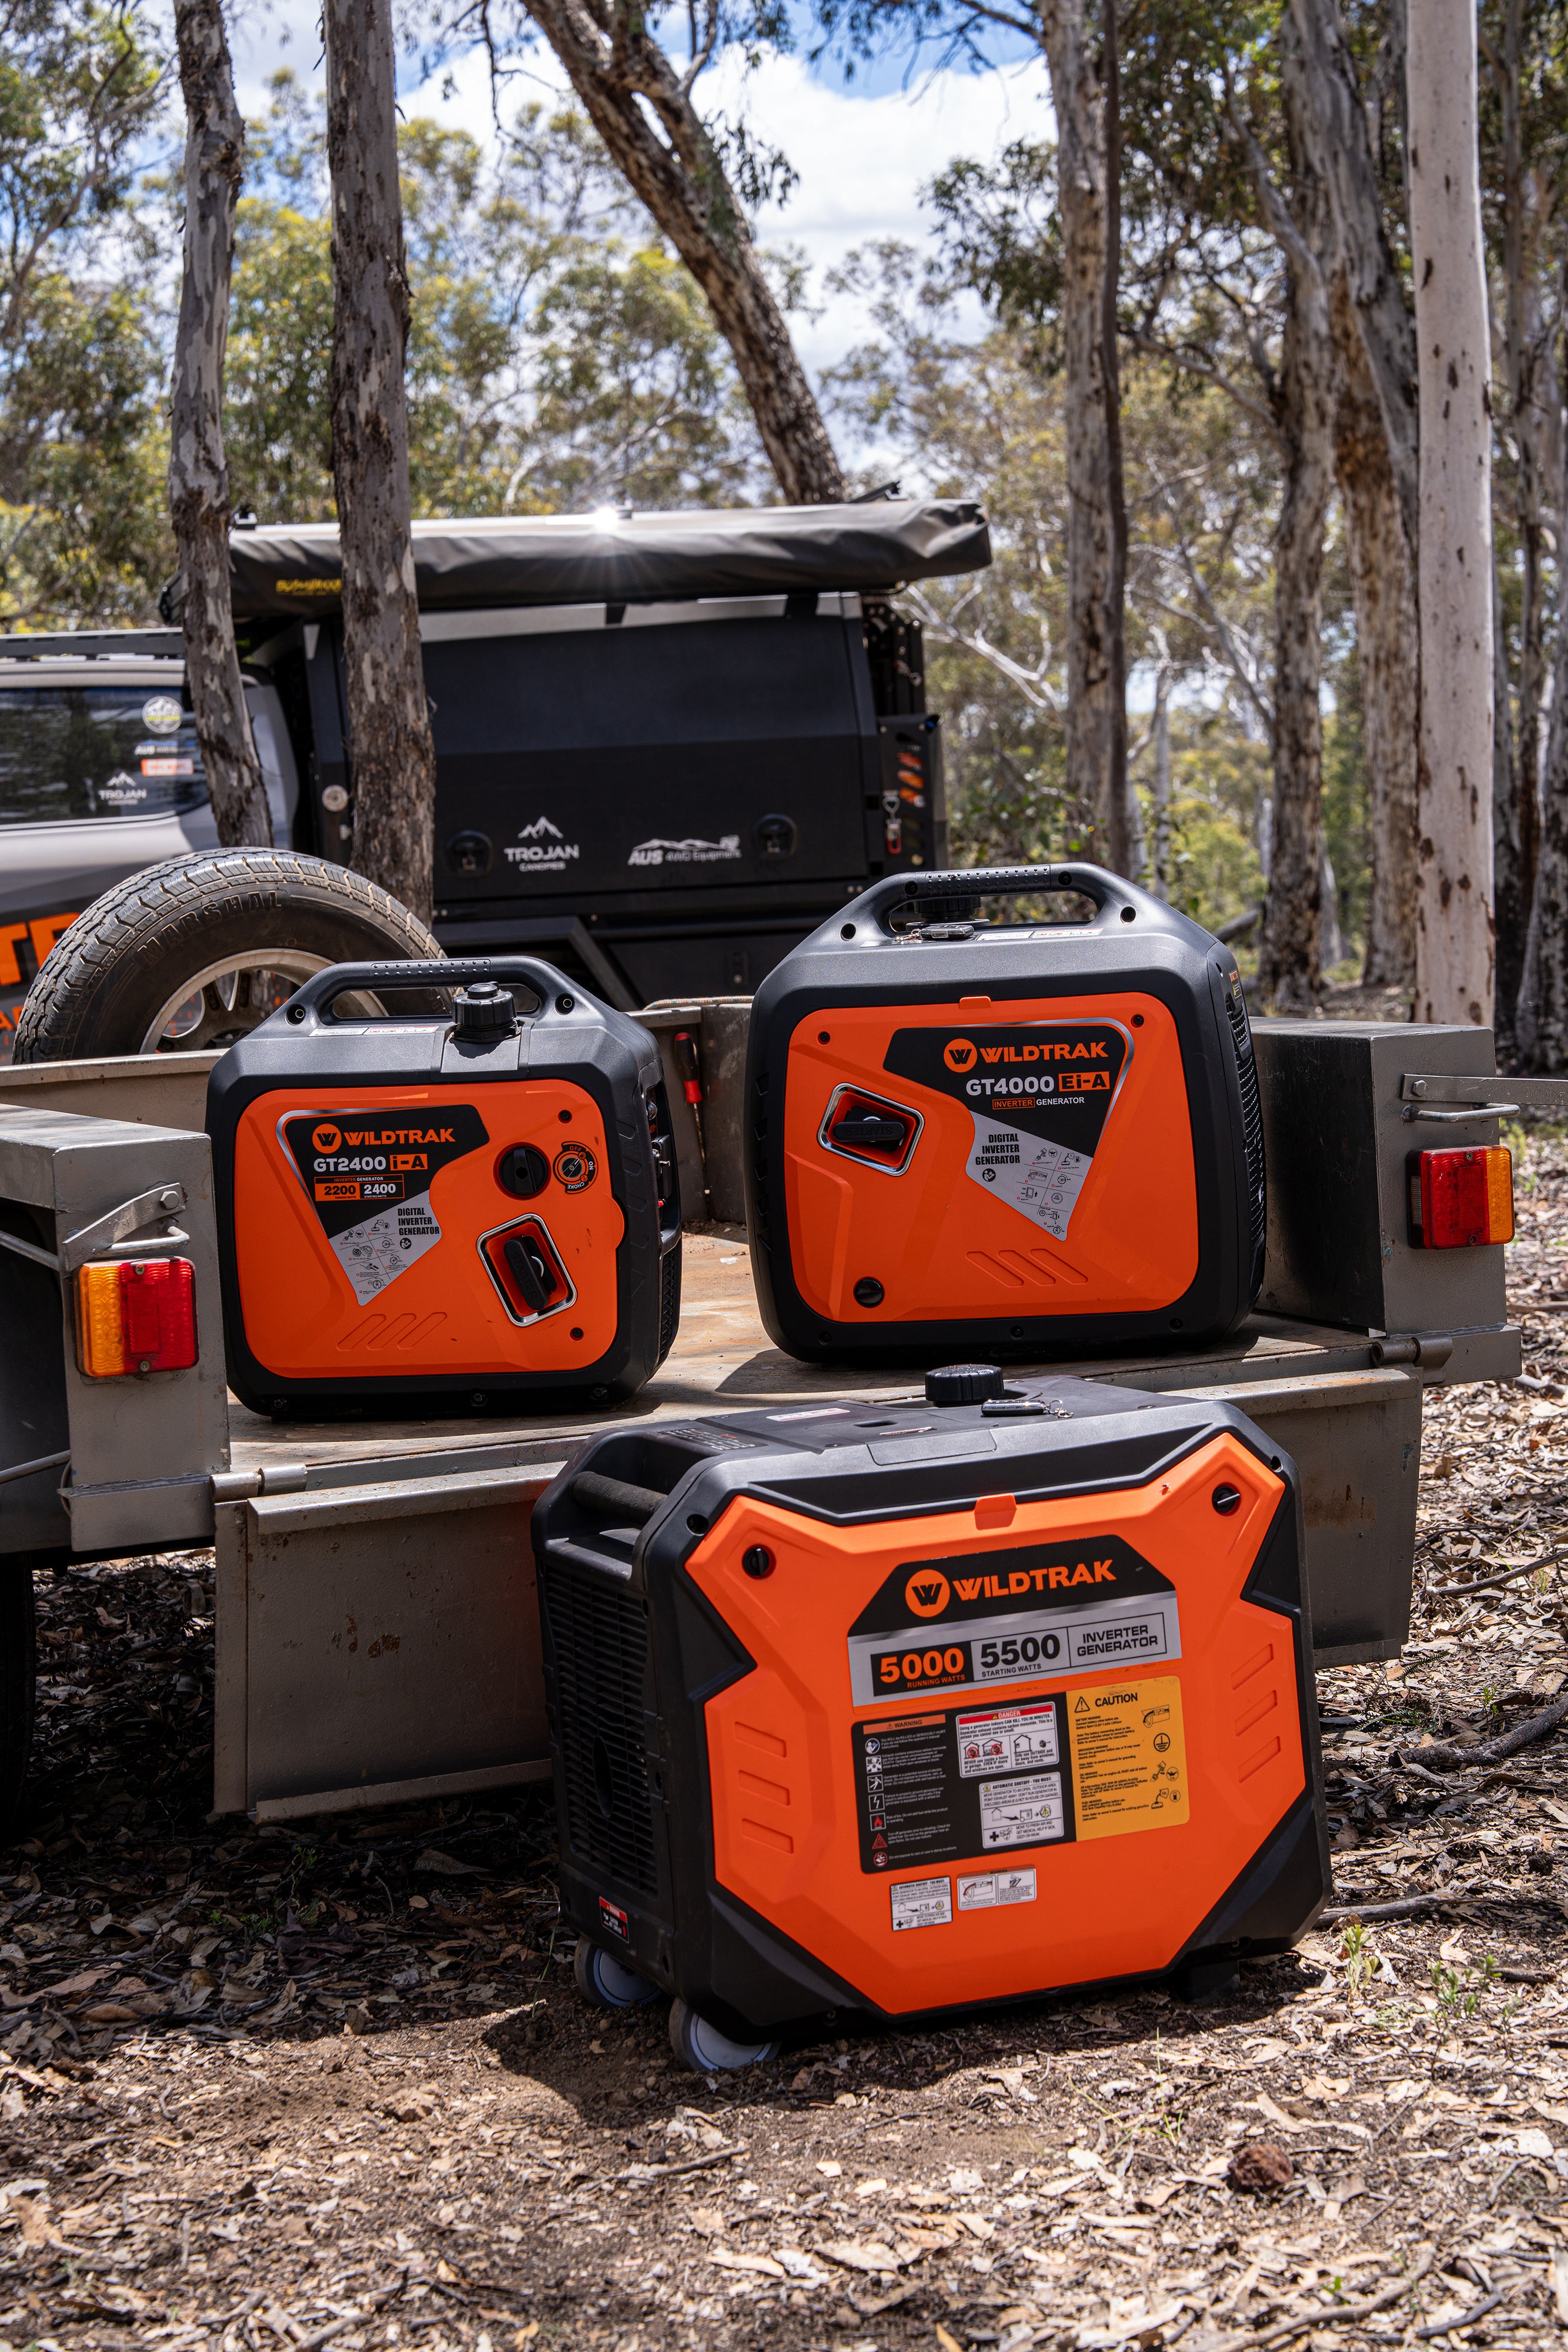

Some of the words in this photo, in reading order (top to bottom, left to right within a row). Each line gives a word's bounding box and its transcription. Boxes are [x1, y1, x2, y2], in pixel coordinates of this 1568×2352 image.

[98, 789, 146, 800] TROJAN
[504, 844, 579, 862] TROJAN
[627, 849, 664, 866] AUS
[665, 851, 692, 862] 4WD
[519, 861, 566, 872] CANOPIES
[137, 890, 282, 965] MARSHAL
[979, 1042, 1108, 1063] WILDTRAK
[966, 1076, 1054, 1095] GT4000
[1062, 1074, 1106, 1089] Ei-A
[994, 1100, 1033, 1108] INVERTER
[1037, 1097, 1085, 1105] GENERATOR
[343, 1128, 456, 1146] WILDTRAK
[845, 1126, 893, 1136] STARTER
[988, 1133, 1019, 1143] DIGITAL
[982, 1144, 1019, 1154] INVERTER
[313, 1156, 386, 1172] GT2400
[393, 1155, 425, 1169] i-A
[589, 1161, 593, 1170] ON
[975, 1155, 1020, 1165] GENERATOR
[324, 1185, 356, 1195] 2200
[364, 1184, 396, 1194] 2400
[397, 1207, 425, 1216] DIGITAL
[398, 1217, 432, 1226] INVERTER
[399, 1226, 440, 1235] GENERATOR
[952, 1559, 1116, 1602] WILDTRAK
[1082, 1624, 1149, 1643] INVERTER
[979, 1633, 1061, 1669] 5500
[1076, 1635, 1158, 1657] GENERATOR
[880, 1647, 964, 1683] 5000
[981, 1667, 1017, 1678] STARTING
[1018, 1663, 1042, 1673] WATTS
[907, 1678, 940, 1689] RUNNING
[941, 1674, 965, 1685] WATTS
[1095, 1692, 1138, 1707] CAUTION
[998, 1710, 1021, 1719] DANGER
[894, 1719, 922, 1729] WARNING
